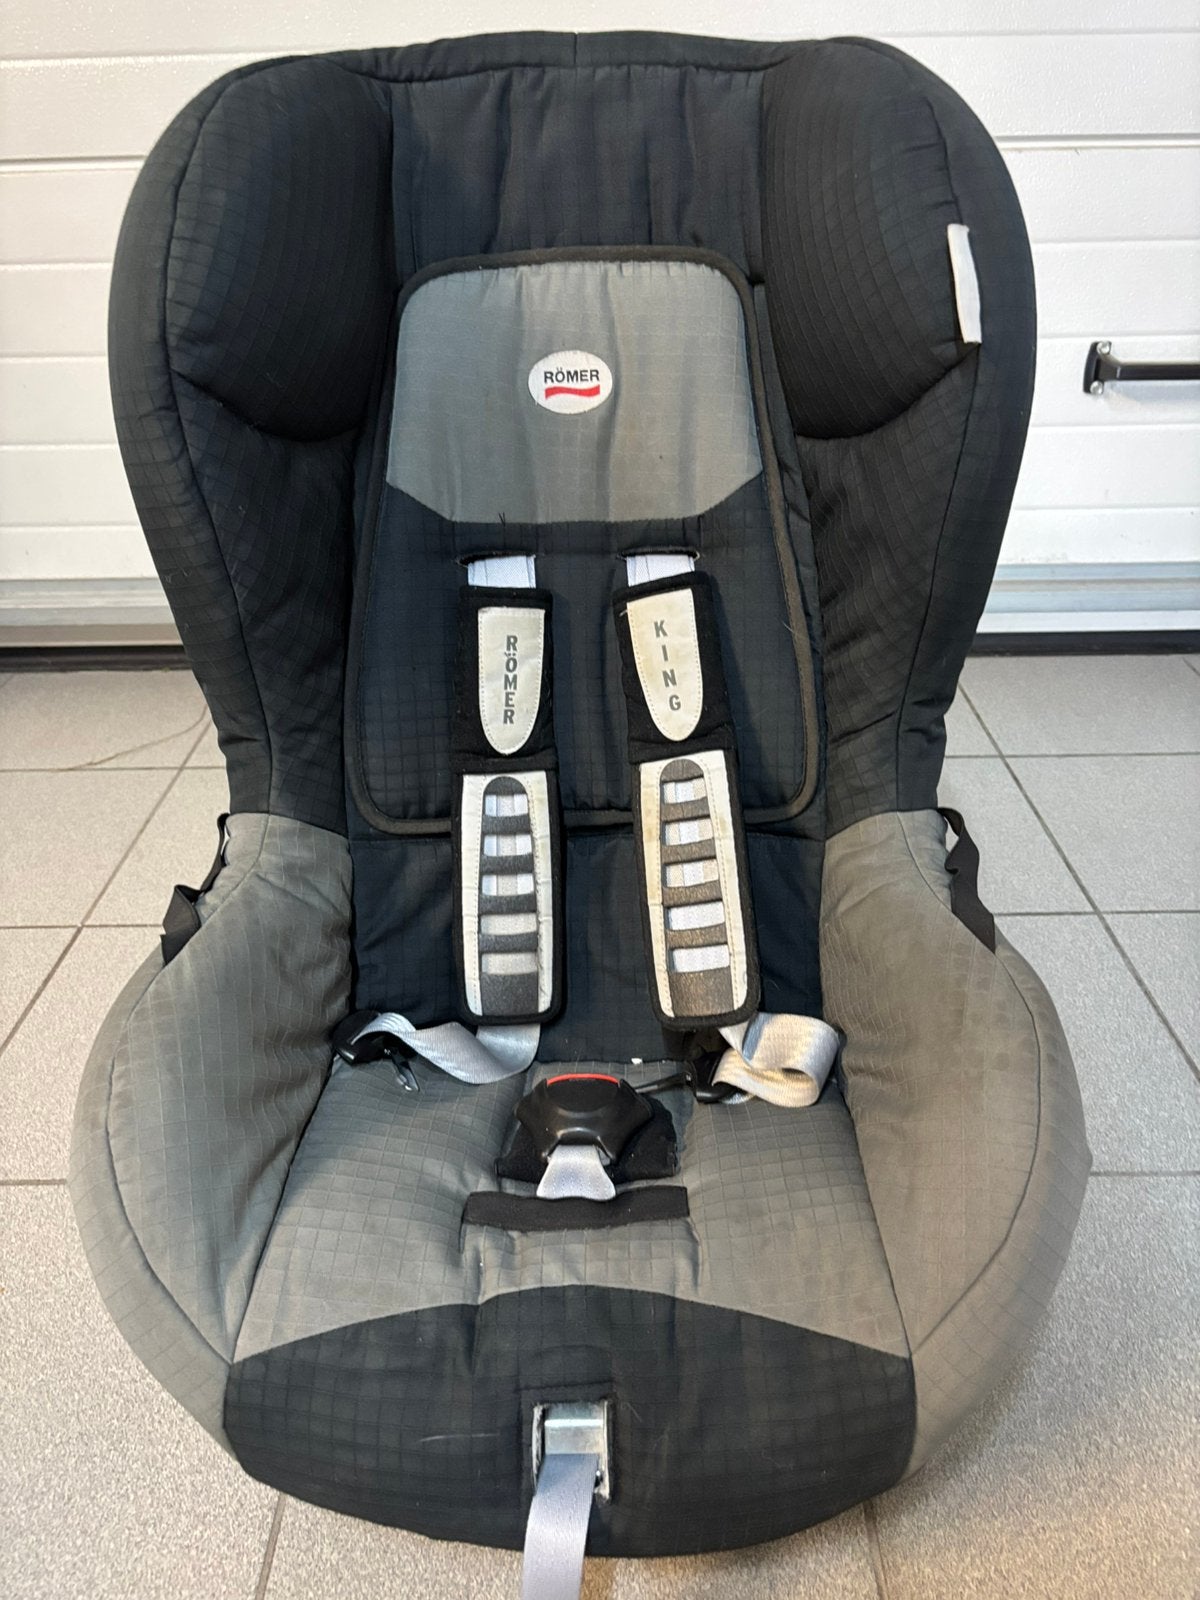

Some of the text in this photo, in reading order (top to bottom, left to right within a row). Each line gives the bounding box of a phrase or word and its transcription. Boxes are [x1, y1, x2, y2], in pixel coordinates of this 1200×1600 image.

[544, 367, 600, 384] RÖMER
[503, 635, 518, 724] RÖMER
[654, 619, 681, 711] KING
